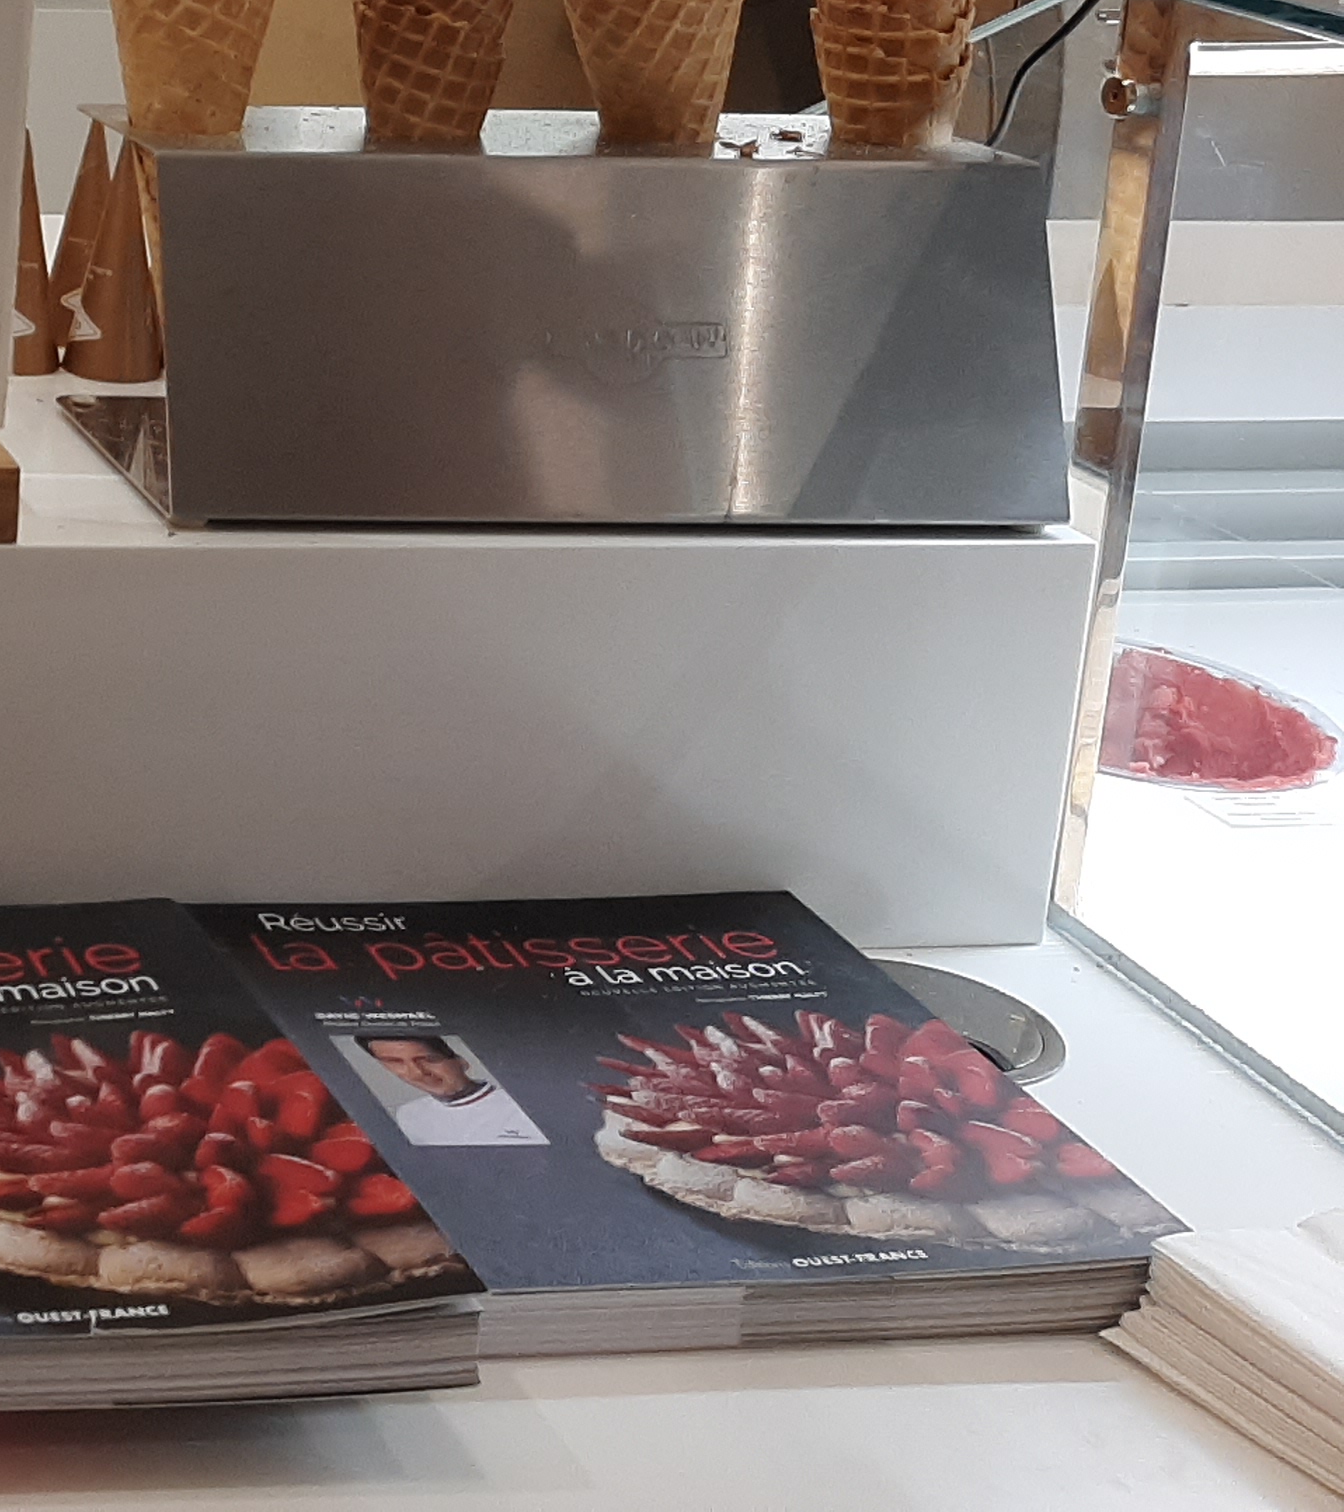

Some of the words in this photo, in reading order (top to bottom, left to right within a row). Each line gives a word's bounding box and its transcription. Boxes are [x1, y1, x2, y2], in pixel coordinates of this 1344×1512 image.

[258, 912, 407, 932] Réussir
[250, 933, 339, 971] la
[365, 923, 778, 980] pâtisserie
[565, 967, 593, 986] à
[595, 964, 644, 986] la
[647, 959, 809, 984] maison
[792, 1249, 929, 1268] OUEST-FRANCE
[17, 1304, 171, 1325] OUEST-FRANCE
